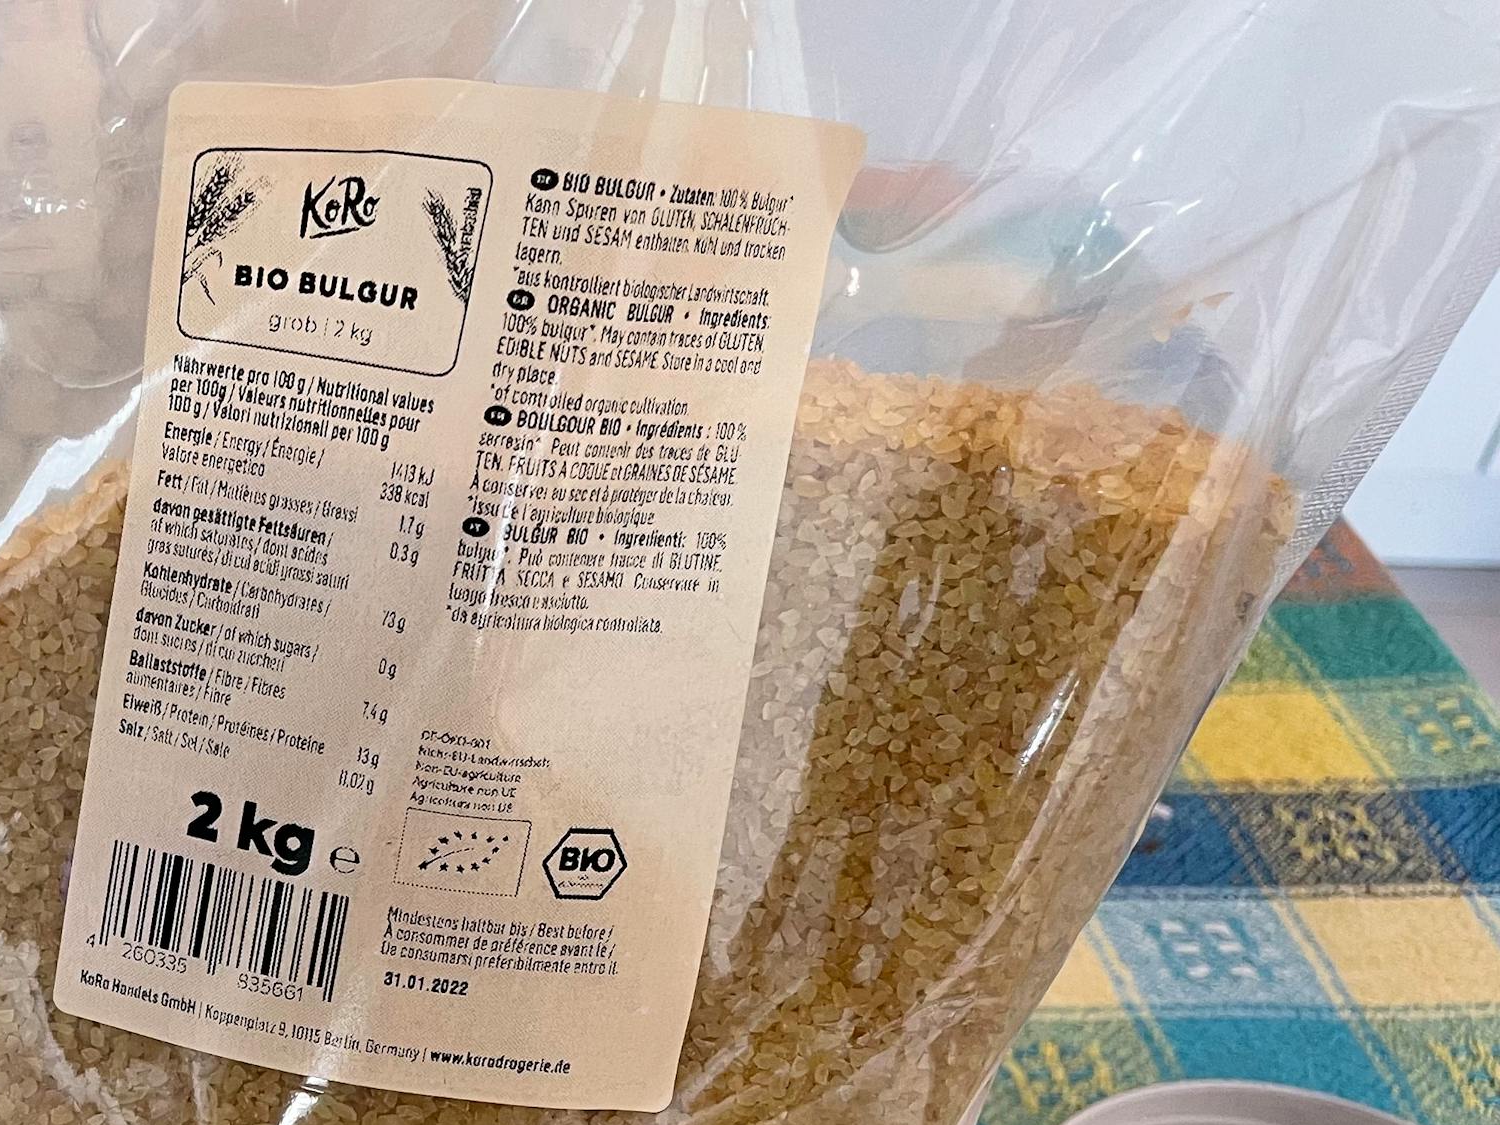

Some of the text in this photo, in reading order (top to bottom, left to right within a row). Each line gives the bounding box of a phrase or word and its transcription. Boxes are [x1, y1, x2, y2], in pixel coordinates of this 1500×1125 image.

[562, 172, 590, 193] BIO
[594, 175, 656, 200] BULGUR
[297, 173, 383, 238] KoRo
[525, 193, 561, 215] Kann
[565, 197, 617, 223] Spuren
[623, 209, 646, 224] von
[520, 216, 548, 238] TEN
[552, 222, 580, 242] und
[584, 225, 632, 247] SESAM
[233, 264, 418, 310] BIO BULGUR
[502, 313, 538, 334] 100%
[546, 295, 616, 319] ORGANIC
[626, 302, 674, 323] BULGUR
[349, 323, 373, 346] kg
[496, 336, 546, 359] EDIBLE
[549, 343, 587, 364] NUTS
[589, 349, 612, 366] and
[172, 354, 435, 413] Nährwerte pro 100 g Nutritional values
[491, 360, 515, 382] dry
[170, 377, 192, 394] per
[237, 384, 287, 408] Valeurs
[388, 415, 420, 433] pour
[167, 394, 191, 412] 100
[193, 401, 201, 418] g
[212, 401, 251, 422] Valori
[330, 425, 353, 443] per
[355, 426, 379, 444] 100
[380, 433, 389, 451] g
[516, 409, 596, 434] BOULGOUR
[599, 417, 621, 435] BIO
[157, 470, 183, 488] Fett
[404, 487, 430, 507] kcal
[152, 497, 326, 545] davon gesättigte Fettsäuren
[143, 561, 233, 595] Kohlenhydrate
[135, 607, 173, 627] davon
[174, 614, 217, 636] Zucker
[272, 638, 311, 660] sugars
[129, 649, 207, 680] Ballaststoffe
[215, 668, 243, 689] Fibre
[118, 718, 144, 737] Salz
[169, 703, 209, 726] Protein
[277, 728, 325, 754] Proteine
[185, 787, 317, 878] 2 kg
[558, 848, 616, 872] BIO
[86, 932, 303, 1001] 4 260335 835661
[383, 971, 469, 995] 31.01.2022
[80, 969, 110, 989] KoRo
[111, 978, 158, 1003] Handels
[160, 991, 195, 1013] GmbH
[291, 1024, 320, 1043] 10115
